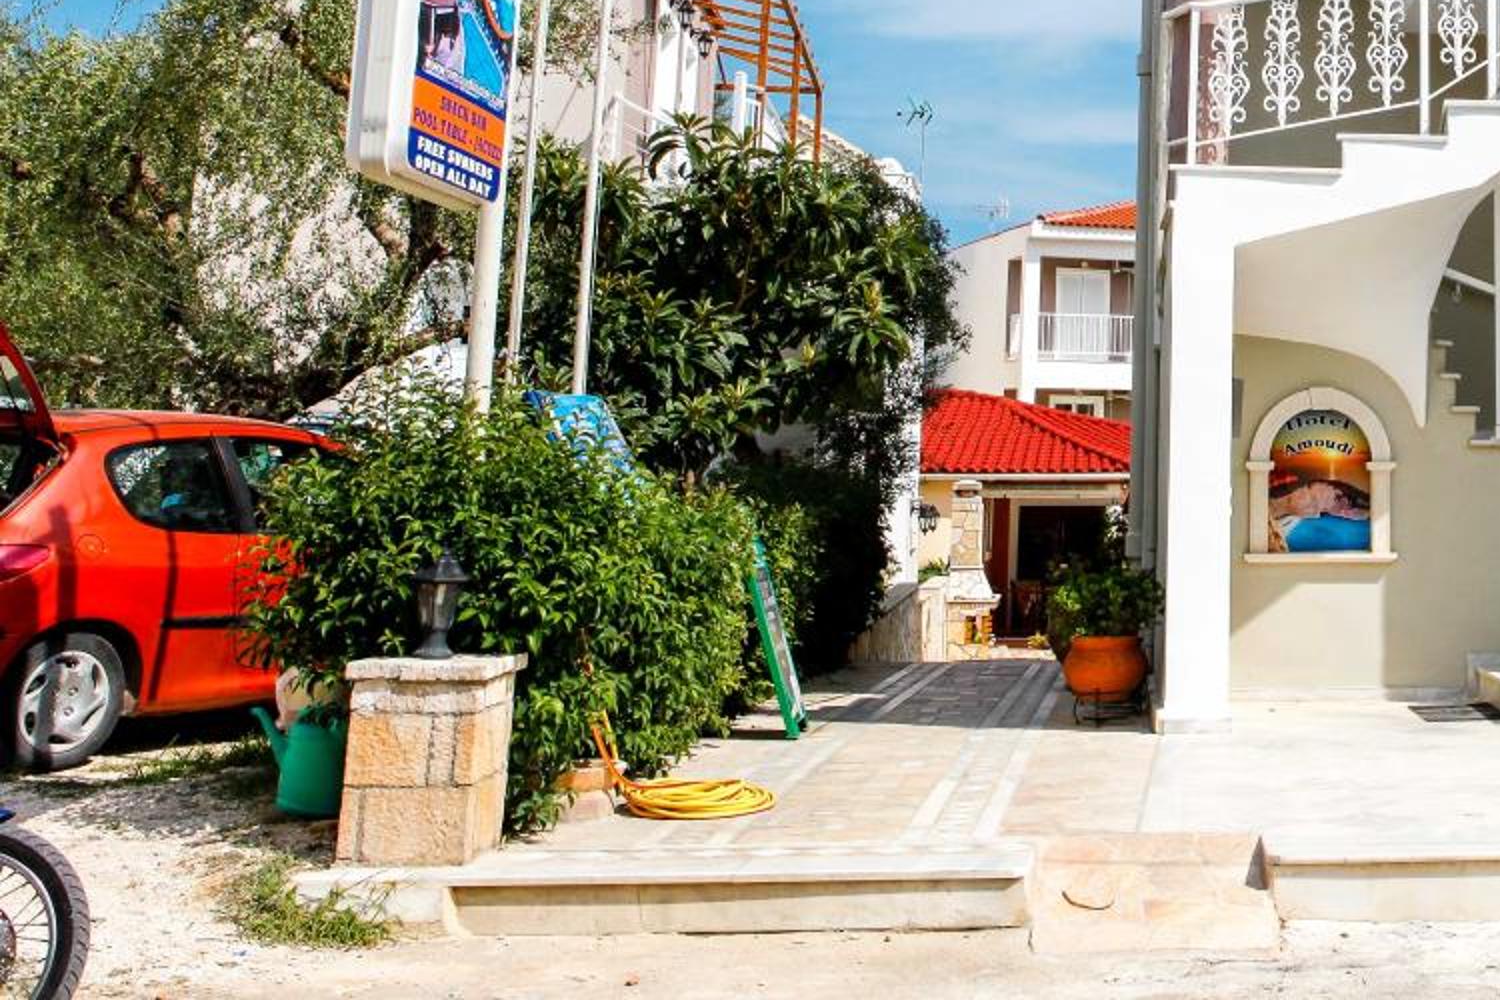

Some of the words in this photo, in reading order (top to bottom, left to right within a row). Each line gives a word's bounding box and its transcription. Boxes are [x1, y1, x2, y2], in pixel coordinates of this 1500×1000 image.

[414, 107, 437, 131] POOL
[417, 135, 446, 160] FREE
[415, 154, 445, 179] OPEN
[445, 167, 467, 189] ALL
[469, 177, 492, 197] DAY
[1285, 415, 1350, 431] Hotel
[1285, 439, 1355, 456] Amoudi
